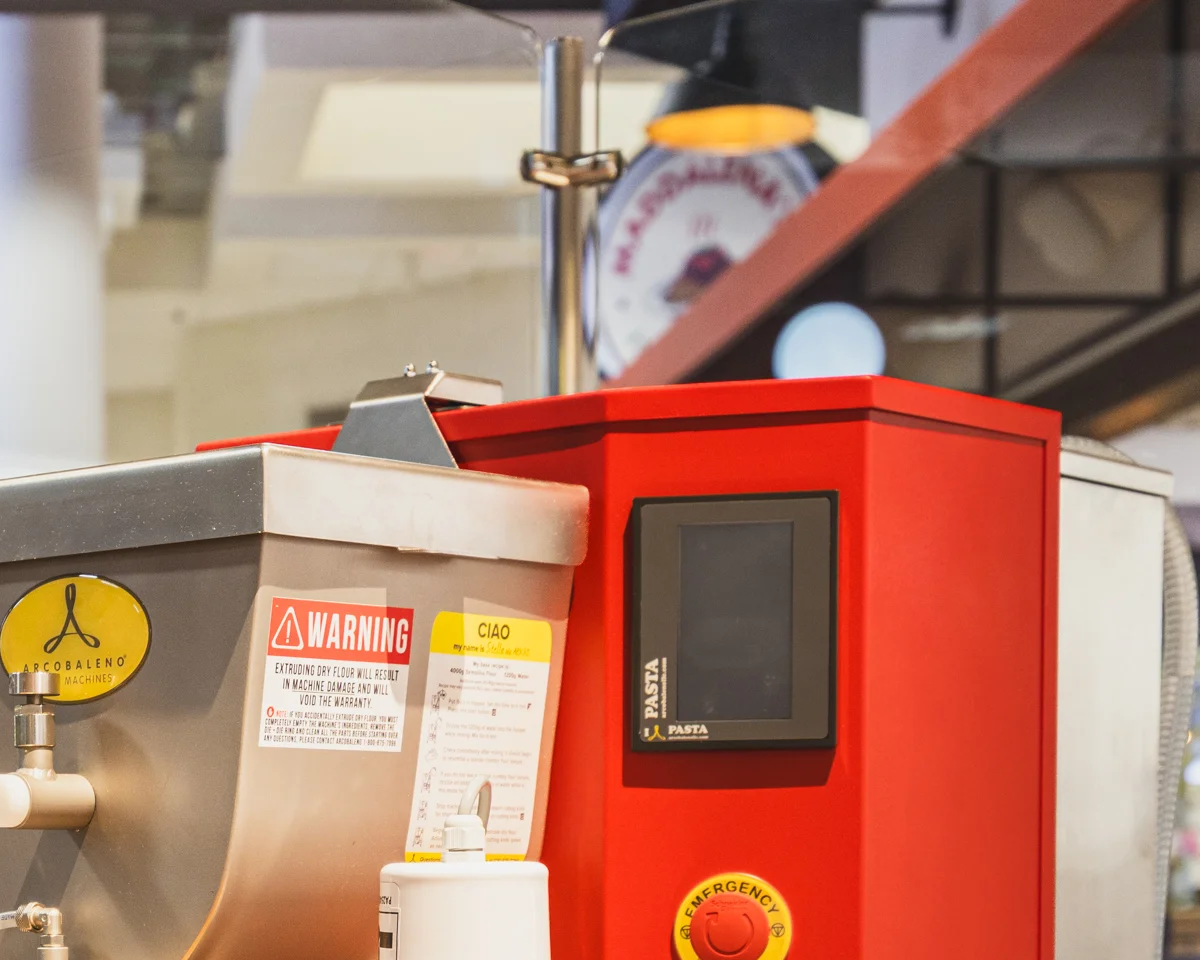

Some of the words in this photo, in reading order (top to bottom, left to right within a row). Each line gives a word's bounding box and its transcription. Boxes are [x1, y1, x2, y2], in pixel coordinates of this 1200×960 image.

[308, 611, 409, 654] WARNING
[477, 622, 511, 640] CIAO
[453, 643, 462, 652] my
[462, 644, 478, 652] name
[480, 643, 485, 653] is
[23, 656, 125, 673] ARCOBALENO
[275, 662, 315, 677] EXTRUDING
[317, 665, 331, 677] DRY
[333, 666, 355, 679] FLOUR
[356, 668, 373, 680] WILL
[374, 669, 399, 682] RESULT
[64, 673, 113, 685] MACHINES
[282, 678, 290, 690] IN
[292, 679, 325, 692] MACHINE
[327, 681, 355, 694] DAMAGE
[358, 683, 371, 695] AND
[373, 683, 389, 696] WILL
[644, 658, 659, 719] PASTA
[299, 694, 317, 706] VOID
[319, 695, 332, 707] THE
[334, 696, 373, 709] WARRANTY.
[265, 718, 291, 726] COMPLETELY
[293, 719, 307, 727] EMPTY
[304, 711, 335, 720] ACCIDENTALLY
[335, 713, 354, 721] EXTRUDE
[296, 727, 305, 735] AND
[668, 724, 708, 734] PASTA
[685, 880, 780, 918] EMERGENCY
